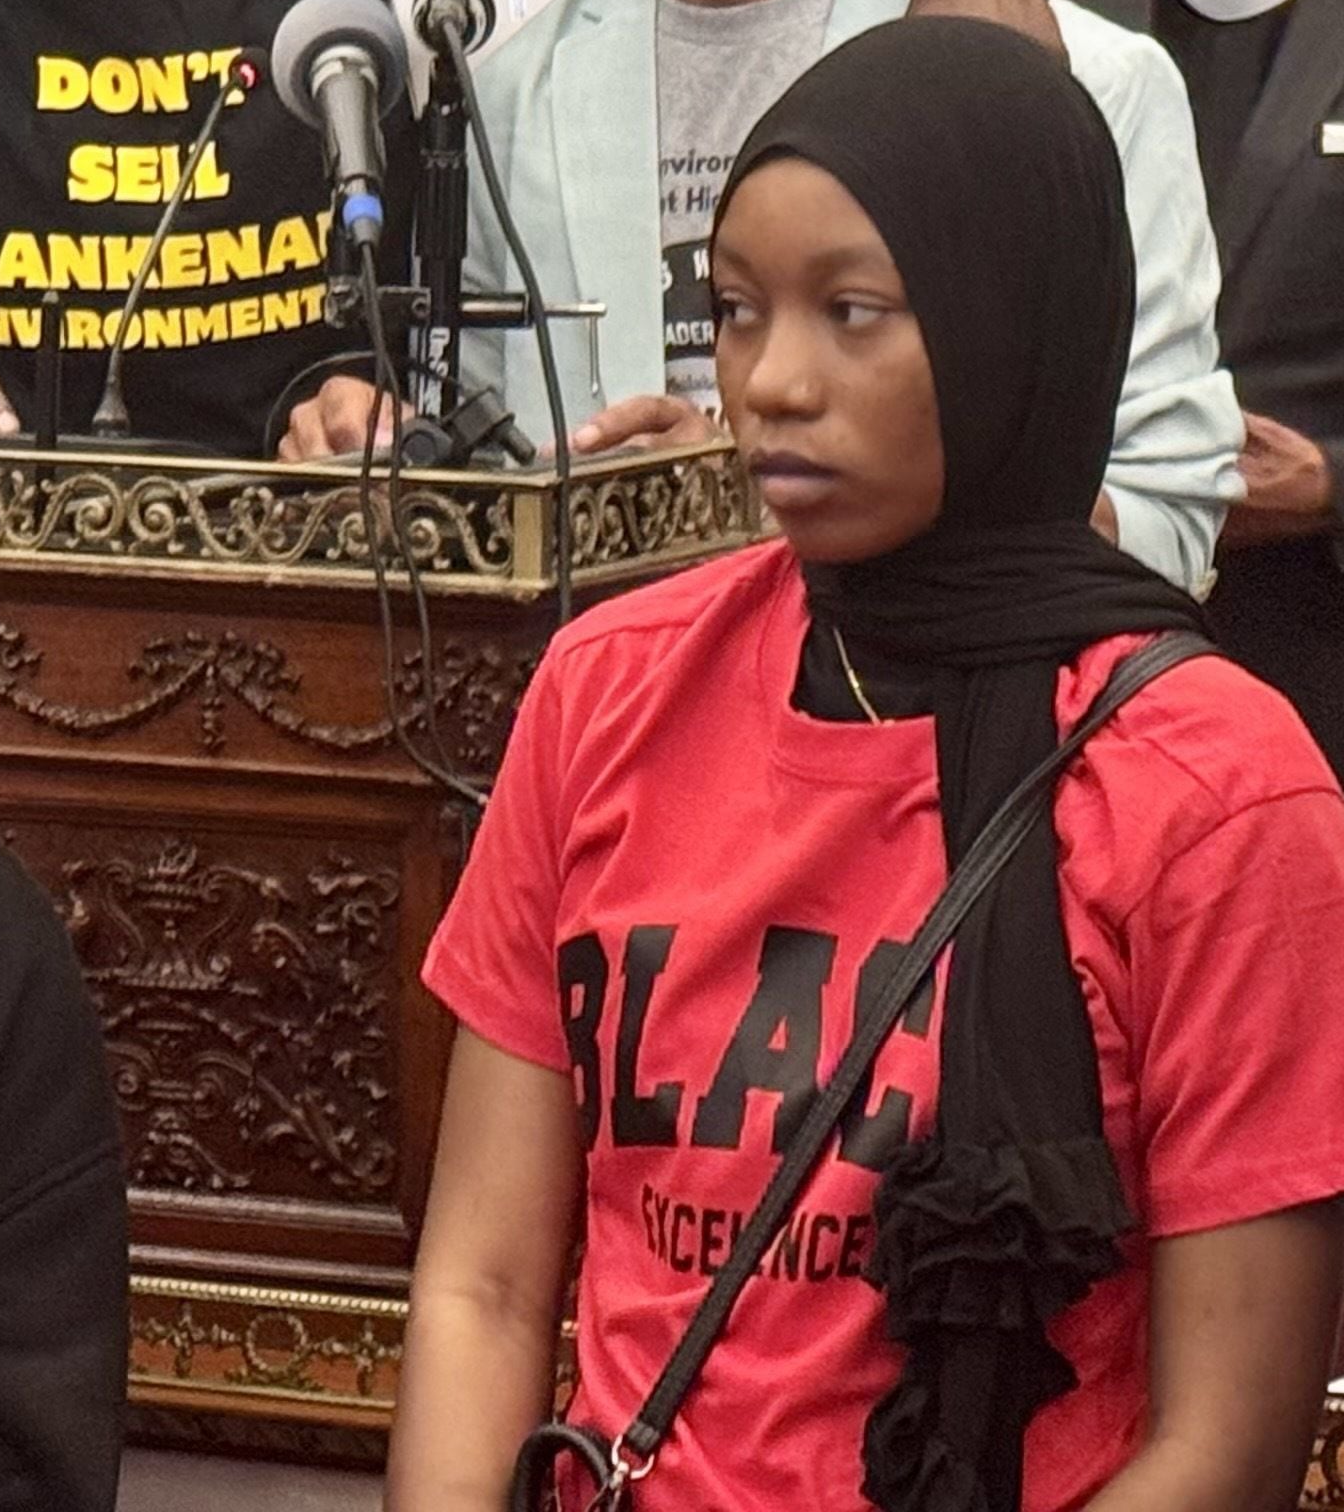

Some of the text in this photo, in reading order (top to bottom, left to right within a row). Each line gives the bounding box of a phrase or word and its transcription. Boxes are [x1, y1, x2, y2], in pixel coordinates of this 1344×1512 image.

[37, 47, 246, 113] DON'T
[68, 140, 230, 203] SELL
[641, 1184, 873, 1281] EXCENCE
